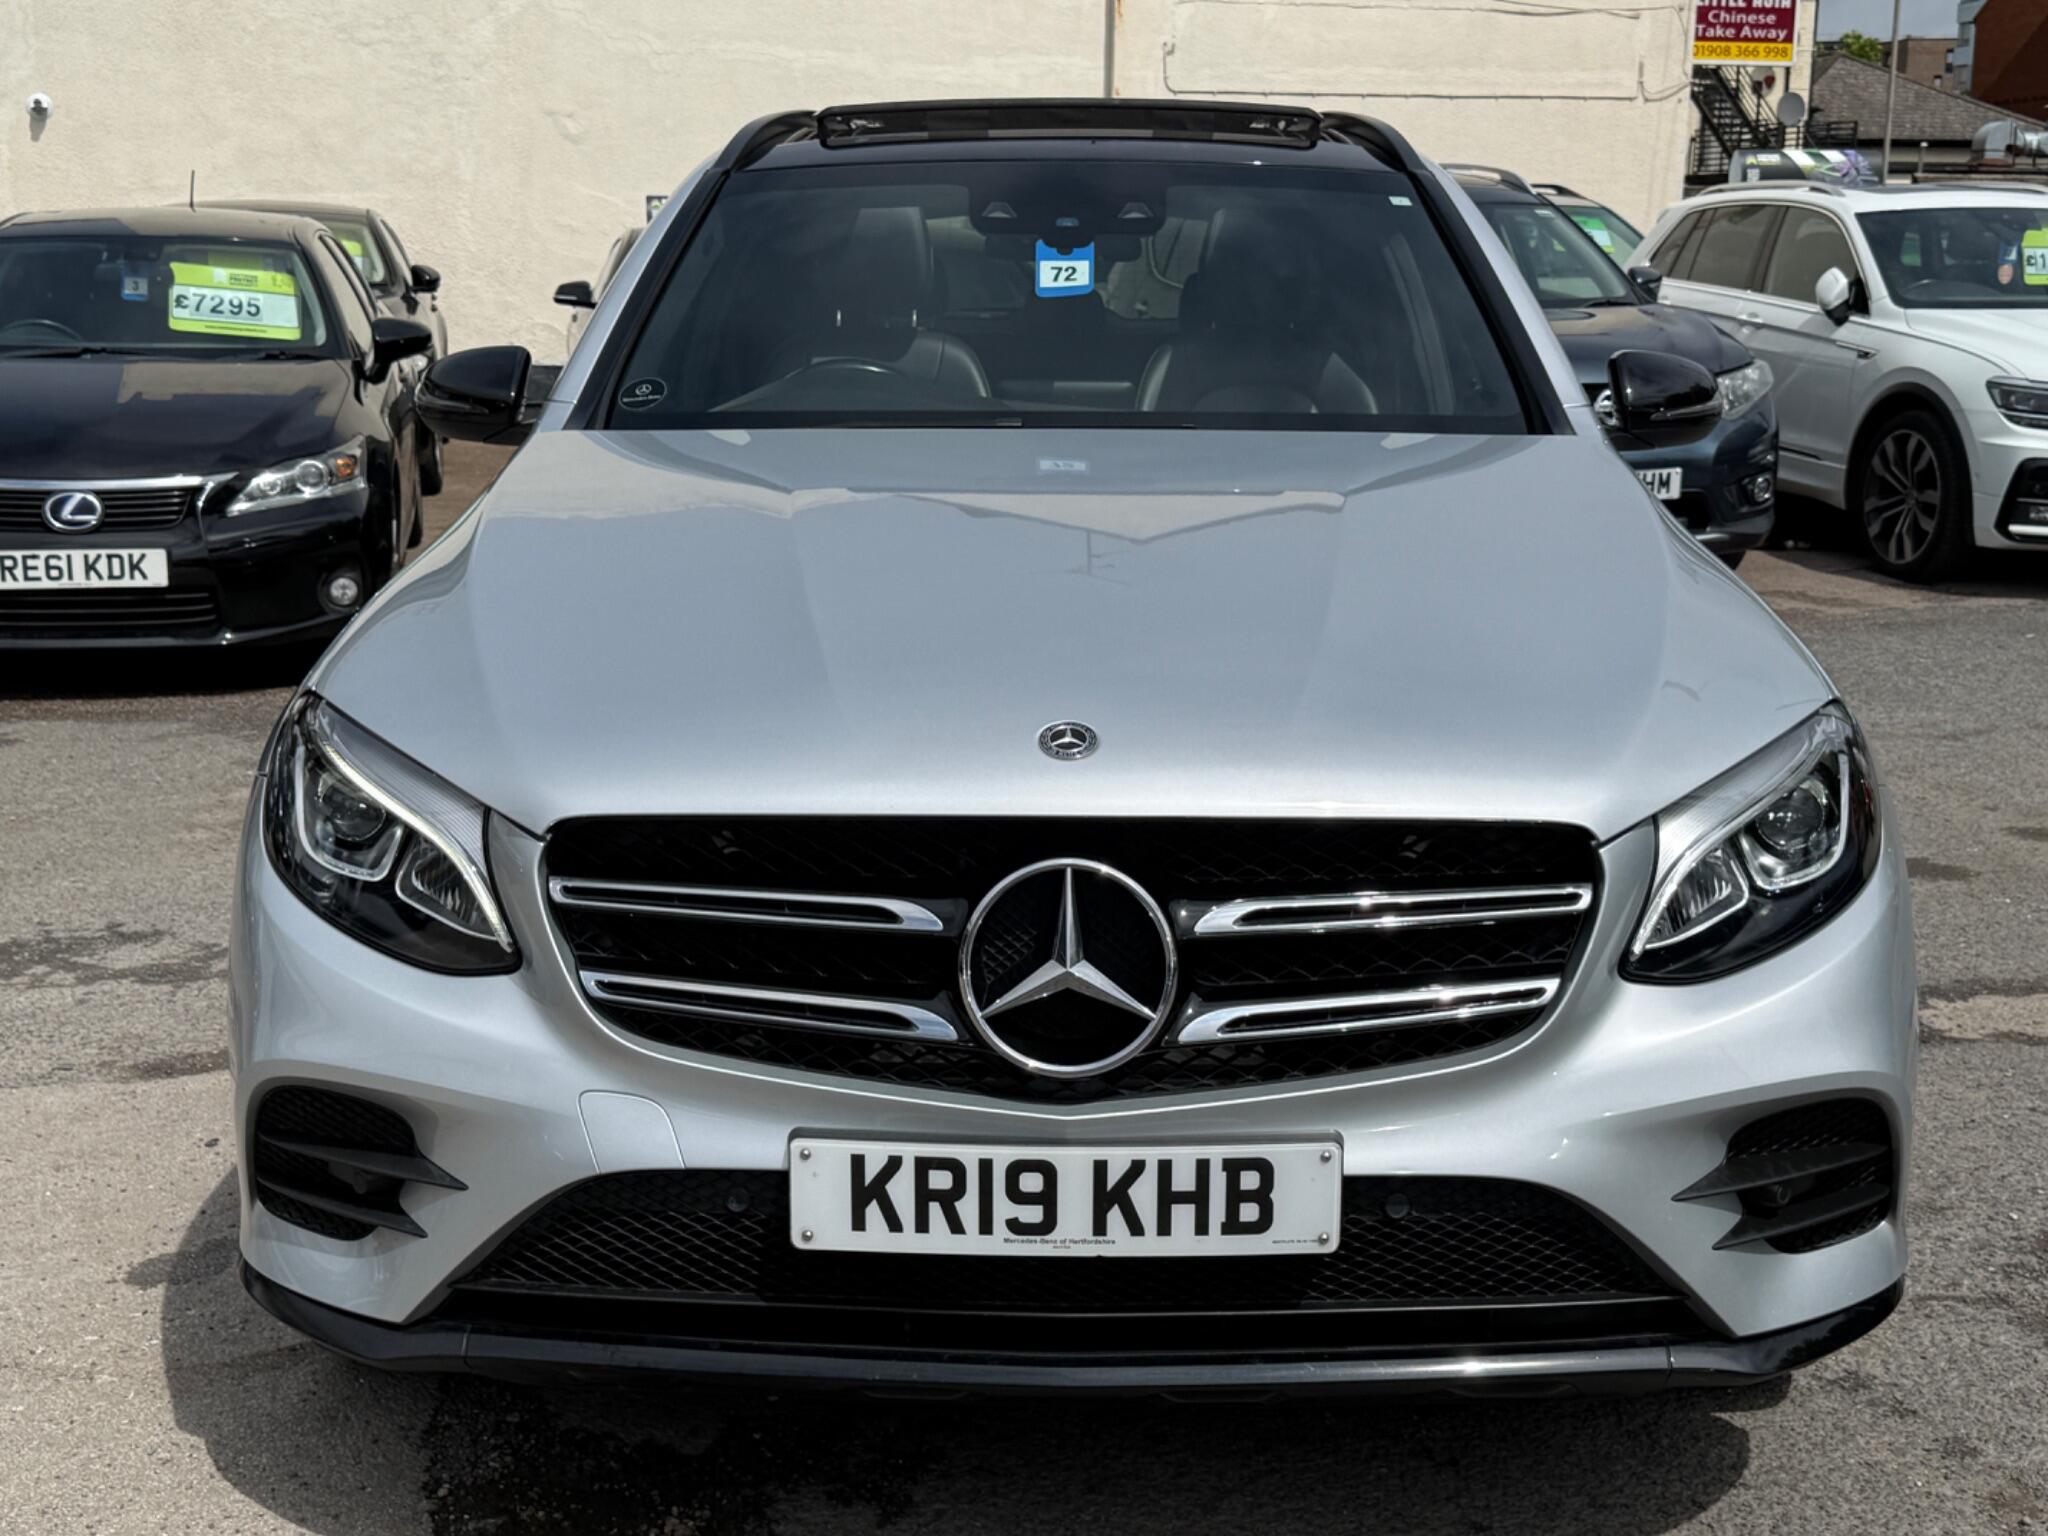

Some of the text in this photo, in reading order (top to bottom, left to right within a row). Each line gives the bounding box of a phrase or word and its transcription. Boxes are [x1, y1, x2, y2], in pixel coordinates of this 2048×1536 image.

[1707, 10, 1777, 25] Chinese
[1696, 24, 1788, 42] Take Away
[1735, 45, 1760, 58] 366
[1763, 46, 1789, 58] 998
[1050, 266, 1078, 282] 72
[131, 281, 140, 291] 3
[174, 293, 261, 317] £7295
[1637, 472, 1671, 494] HM
[0, 553, 148, 583] RE61 KDK
[850, 1153, 1275, 1237] KR19 KHB
